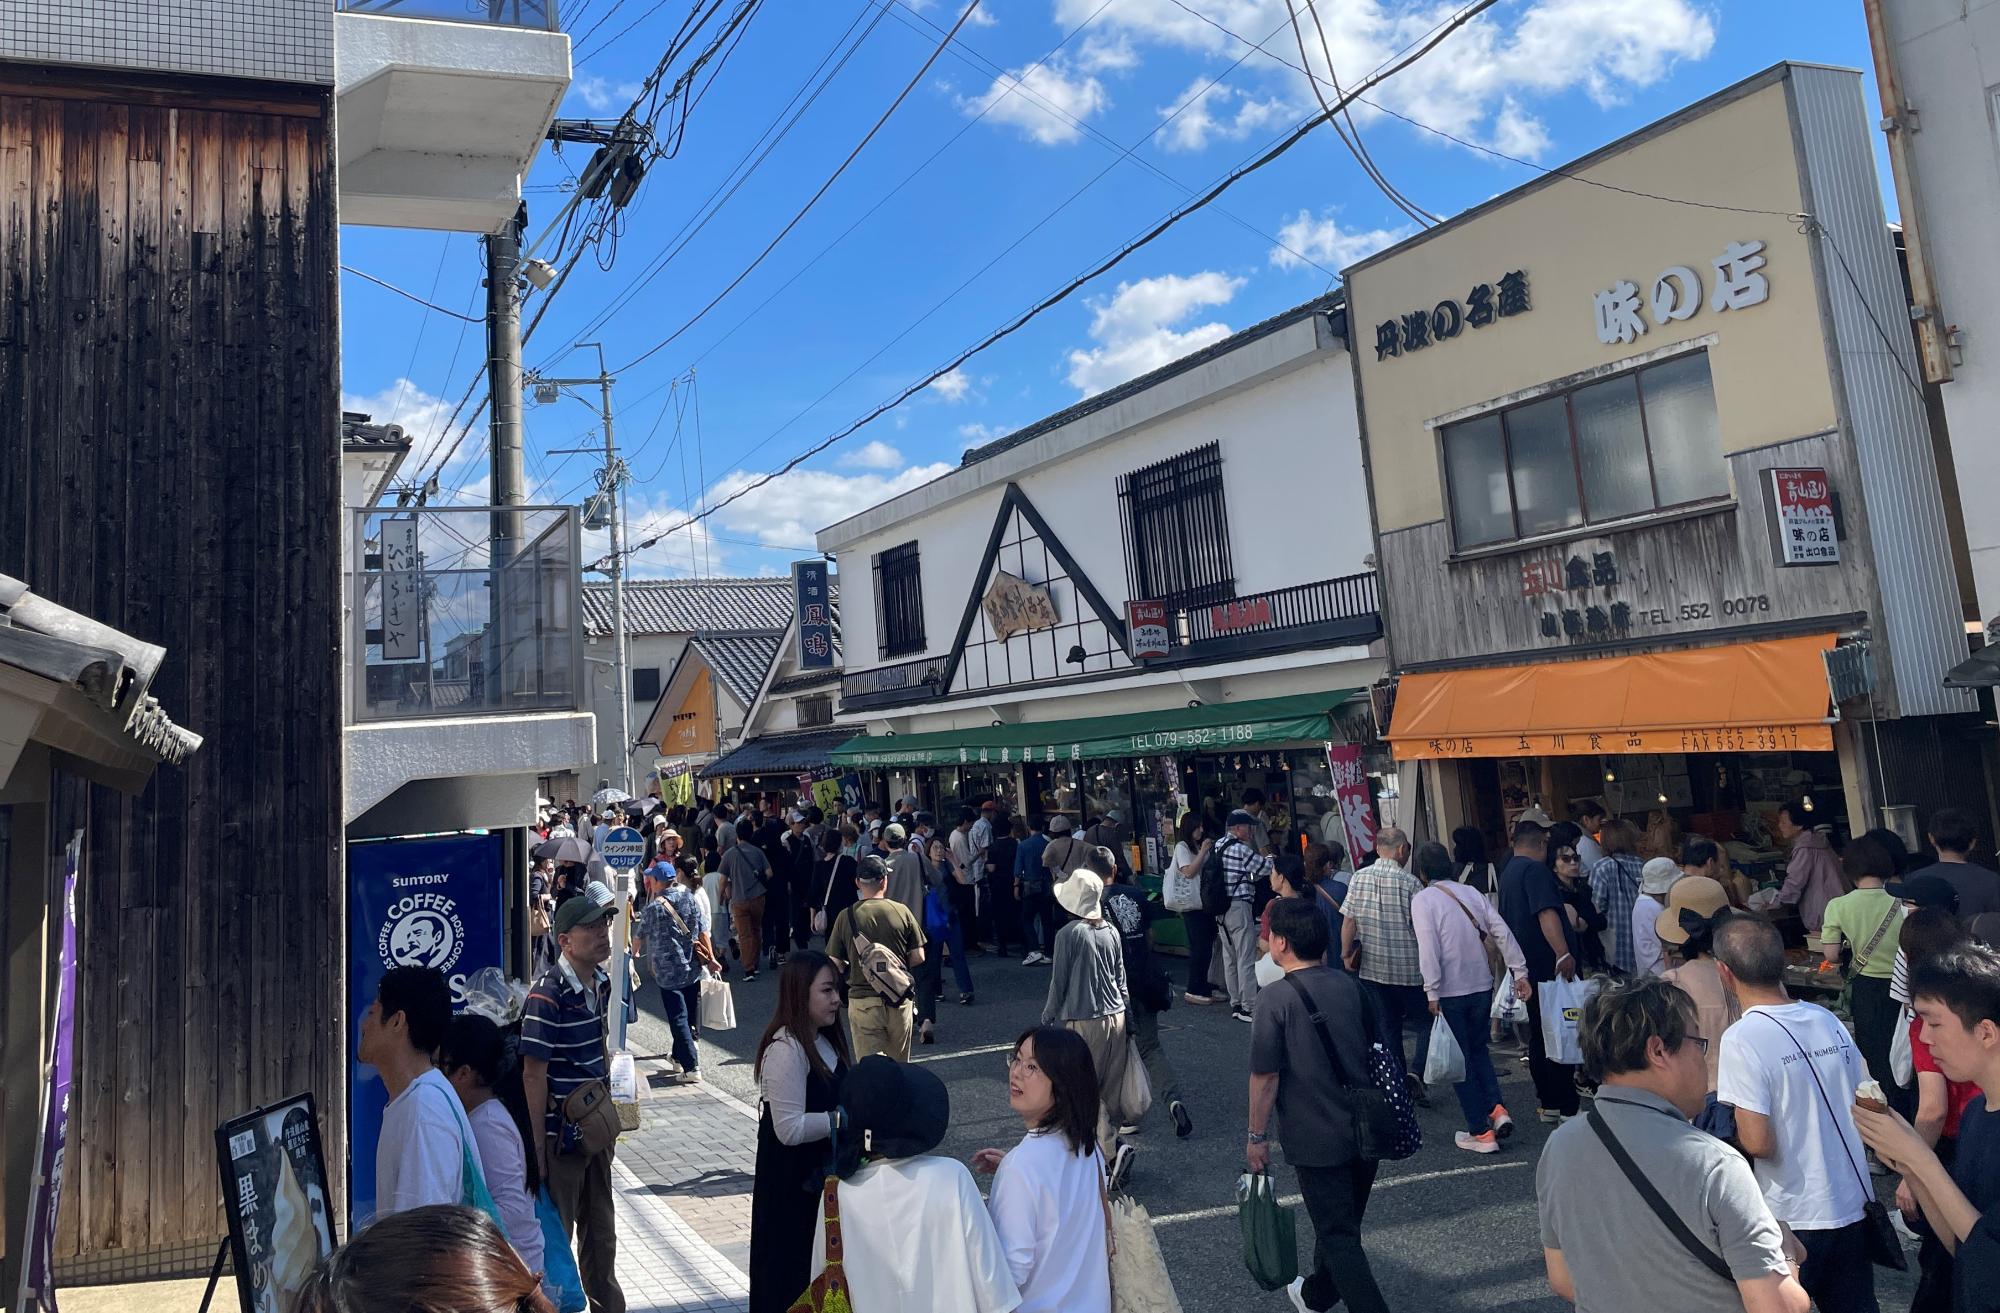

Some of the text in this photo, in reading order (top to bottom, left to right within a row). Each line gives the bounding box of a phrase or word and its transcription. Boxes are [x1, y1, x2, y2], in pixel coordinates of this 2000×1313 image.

[1593, 239, 1770, 344] 味の店
[1375, 269, 1532, 361] 丹波の名産
[1792, 527, 1830, 542] 味の店
[1680, 603, 1712, 621] 552
[1723, 594, 1771, 616] 0078
[1131, 724, 1253, 749] TEL 079-552-1188
[1428, 731, 1642, 754] 味の店 玉川食品
[1681, 734, 1798, 752] FAX 552-3917
[610, 857, 636, 866] のりば
[387, 893, 457, 920] COFFEE
[449, 914, 465, 938] BOSS
[378, 921, 394, 957] COFFEE
[439, 940, 464, 974] COFFEE
[1781, 1053, 1797, 1065] 2014
